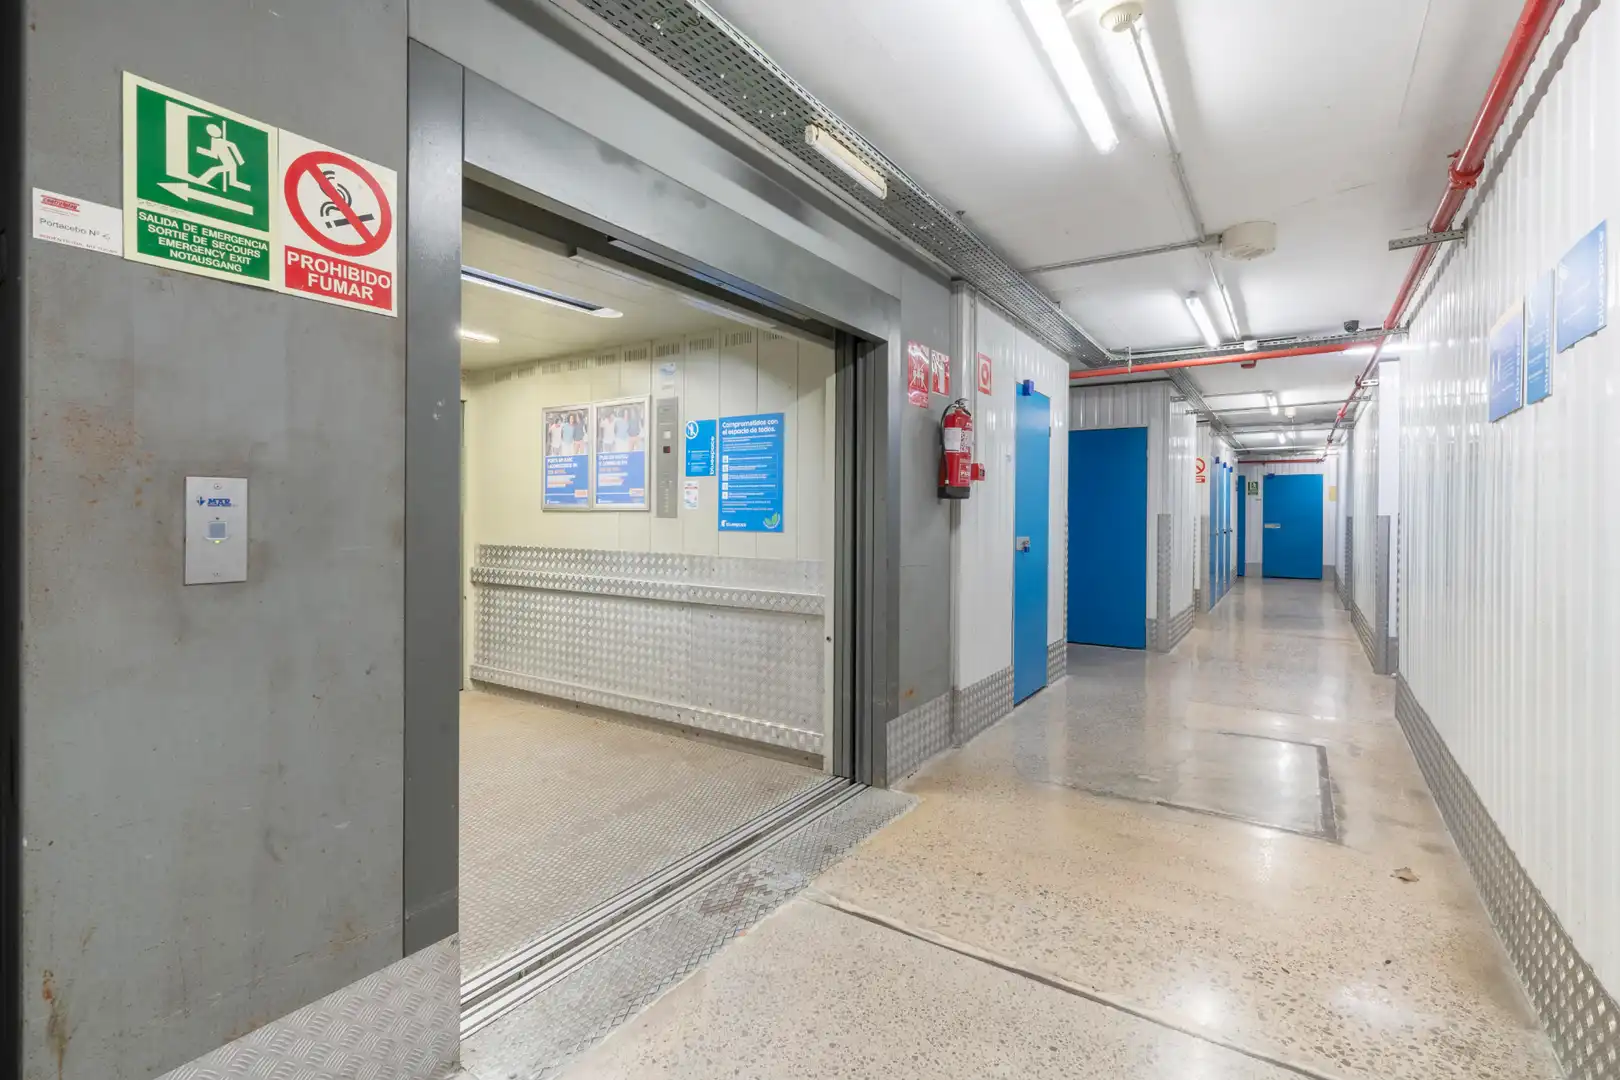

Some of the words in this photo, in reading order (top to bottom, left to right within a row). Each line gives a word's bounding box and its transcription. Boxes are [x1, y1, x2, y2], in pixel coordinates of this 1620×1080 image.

[138, 211, 179, 229] SALIDA
[182, 222, 198, 234] DE
[201, 227, 268, 251] EMERGENCIA
[147, 224, 189, 241] SORTIE
[192, 234, 208, 245] DE
[211, 239, 261, 258] SECOURS
[158, 236, 226, 259] EMERGENCY
[229, 253, 252, 265] EXIT
[169, 249, 242, 273] NOTAUSGANG
[287, 250, 391, 289] PROHIBIDO
[307, 272, 374, 301] FUMAR
[722, 419, 766, 428] Comprometidos
